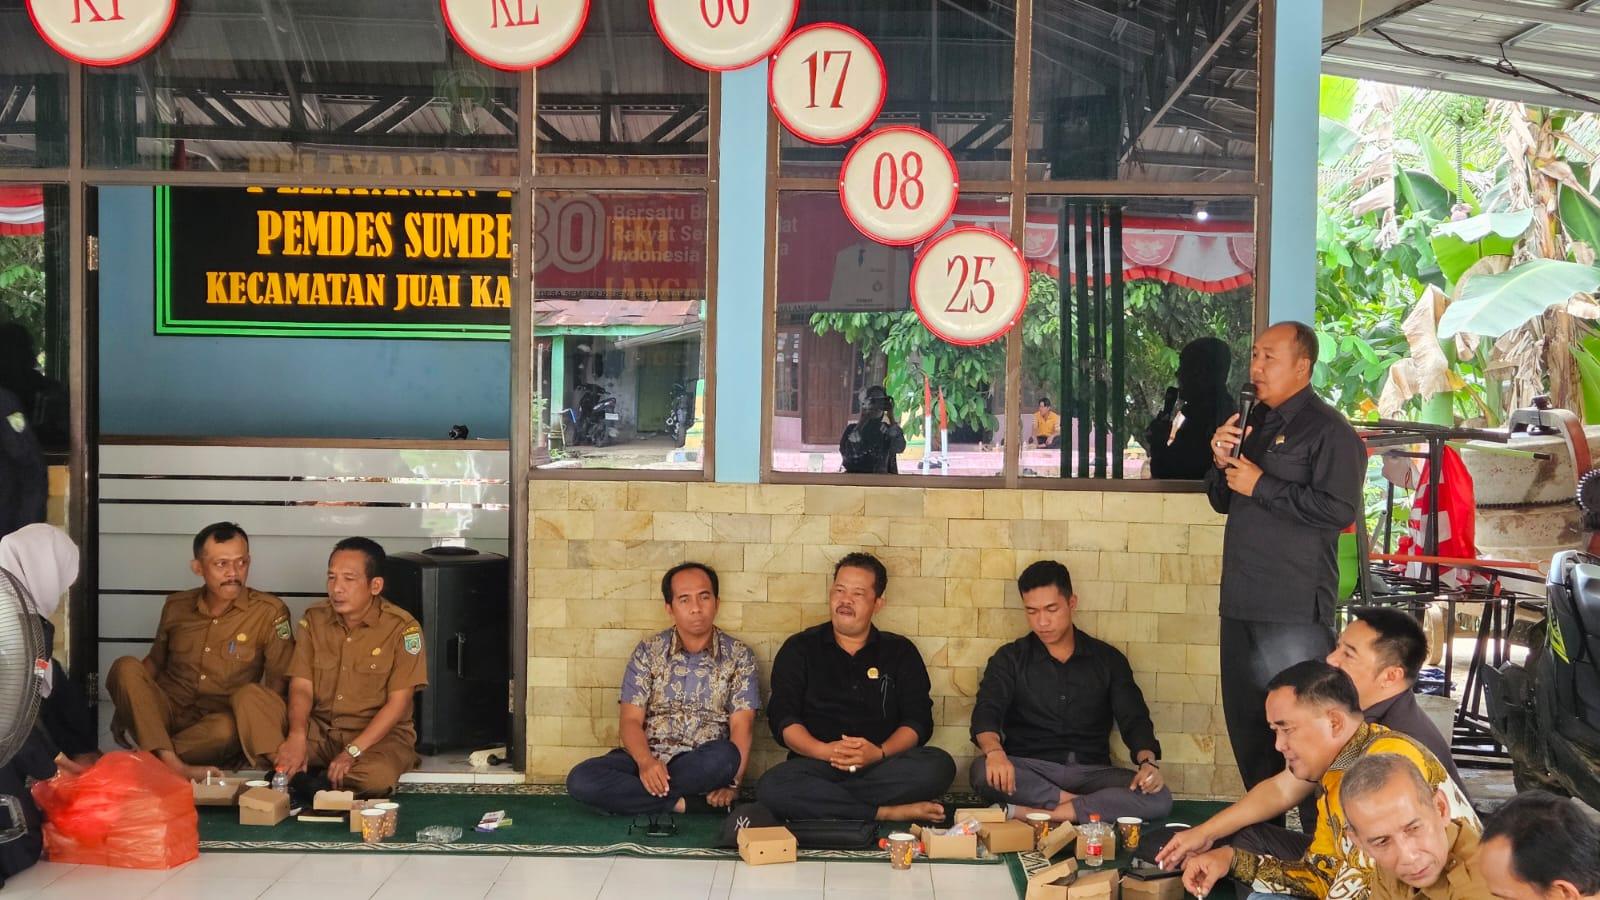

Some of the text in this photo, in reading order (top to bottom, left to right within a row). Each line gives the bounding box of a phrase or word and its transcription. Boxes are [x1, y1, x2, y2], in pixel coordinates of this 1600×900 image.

[801, 50, 852, 109] 17
[872, 151, 924, 210] 08
[257, 210, 393, 257] PEMDES
[404, 212, 511, 259] SUMBE
[613, 204, 686, 220] Bersatu
[612, 247, 700, 263] Indonesia
[205, 272, 385, 307] KECAMATAN
[393, 274, 460, 311] JUAI
[471, 275, 511, 308] KA
[944, 254, 995, 314] 25
